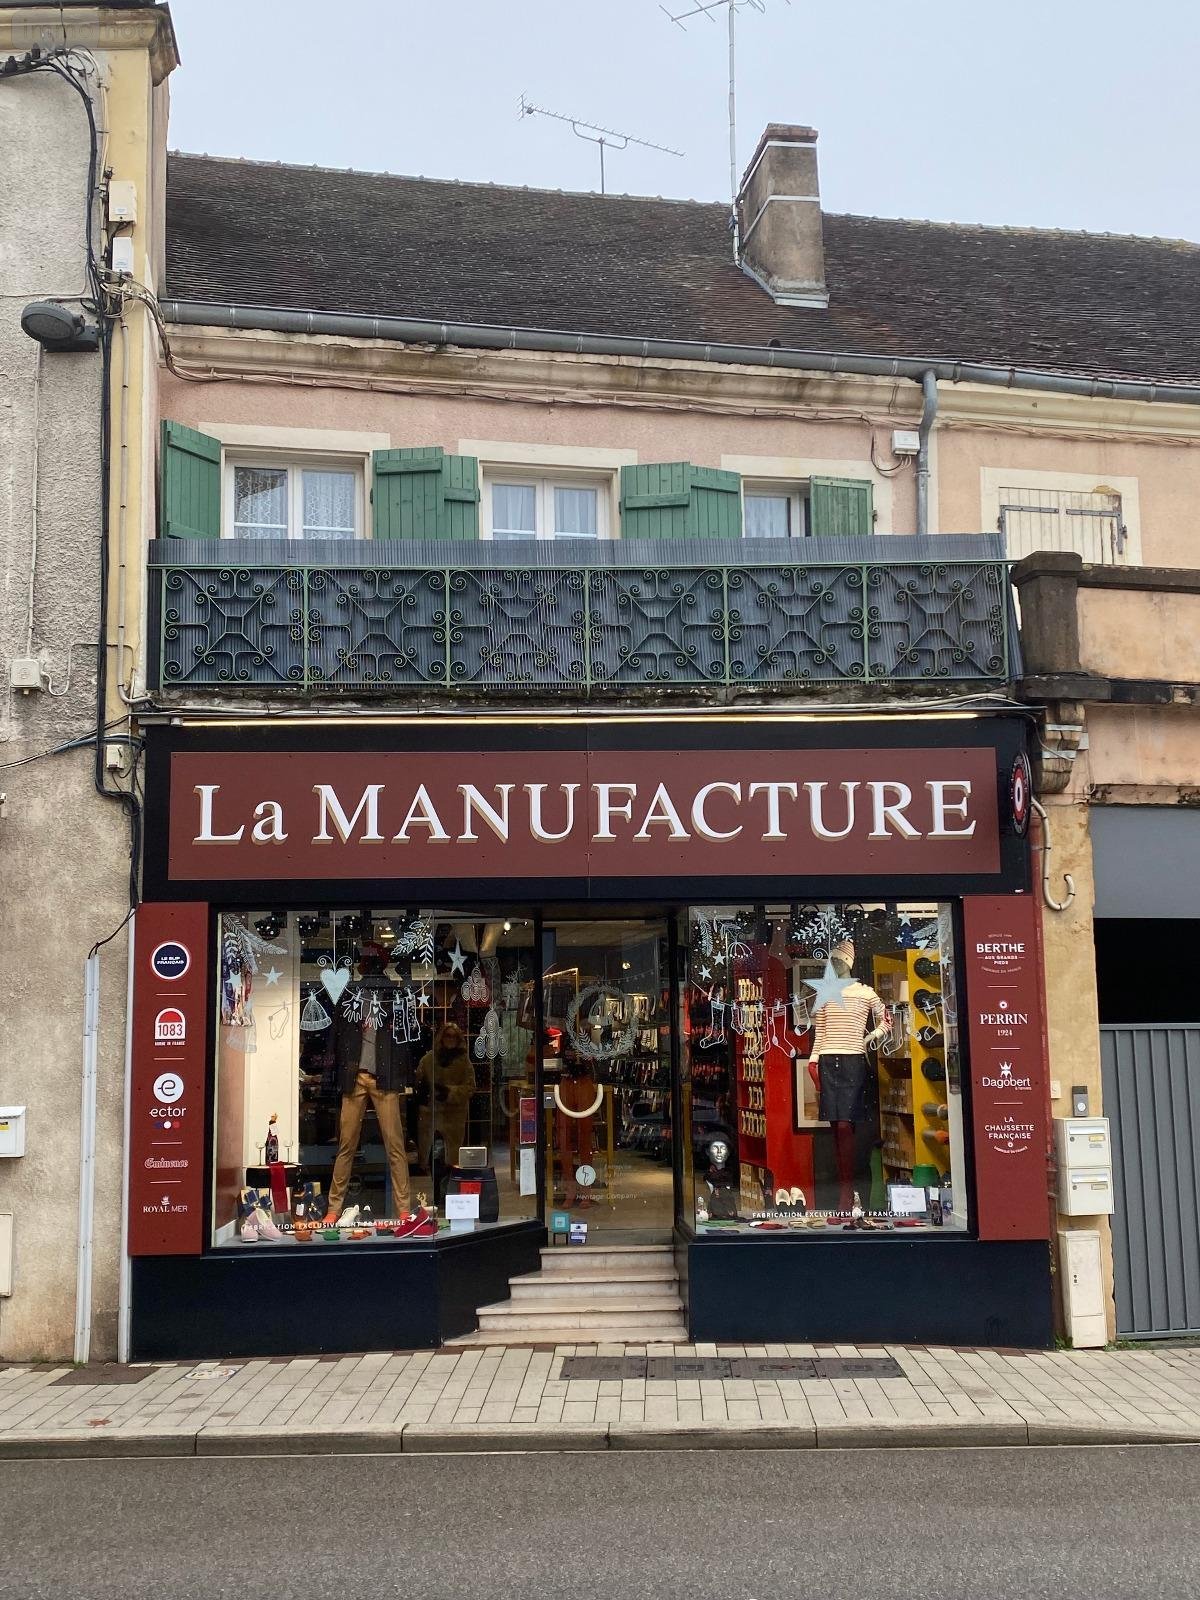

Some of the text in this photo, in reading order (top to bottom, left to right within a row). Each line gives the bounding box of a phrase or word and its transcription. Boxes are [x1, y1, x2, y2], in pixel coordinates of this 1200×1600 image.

[192, 784, 289, 845] La
[311, 781, 977, 845] MANUFACTURE
[976, 943, 1026, 953] BERTHE
[979, 1013, 1029, 1025] PERRIN
[158, 1023, 183, 1037] 1083
[982, 1076, 1031, 1089] Dagobert
[149, 1105, 187, 1118] ector
[988, 1132, 1032, 1140] FRANÇAISE
[144, 1157, 189, 1169] Eminence
[143, 1205, 188, 1213] ROYAL MER
[752, 1210, 911, 1219] FABRICATION EXCLUSIVEMT FRANÇAISE
[298, 1220, 361, 1230] EXCLUSIVNT
